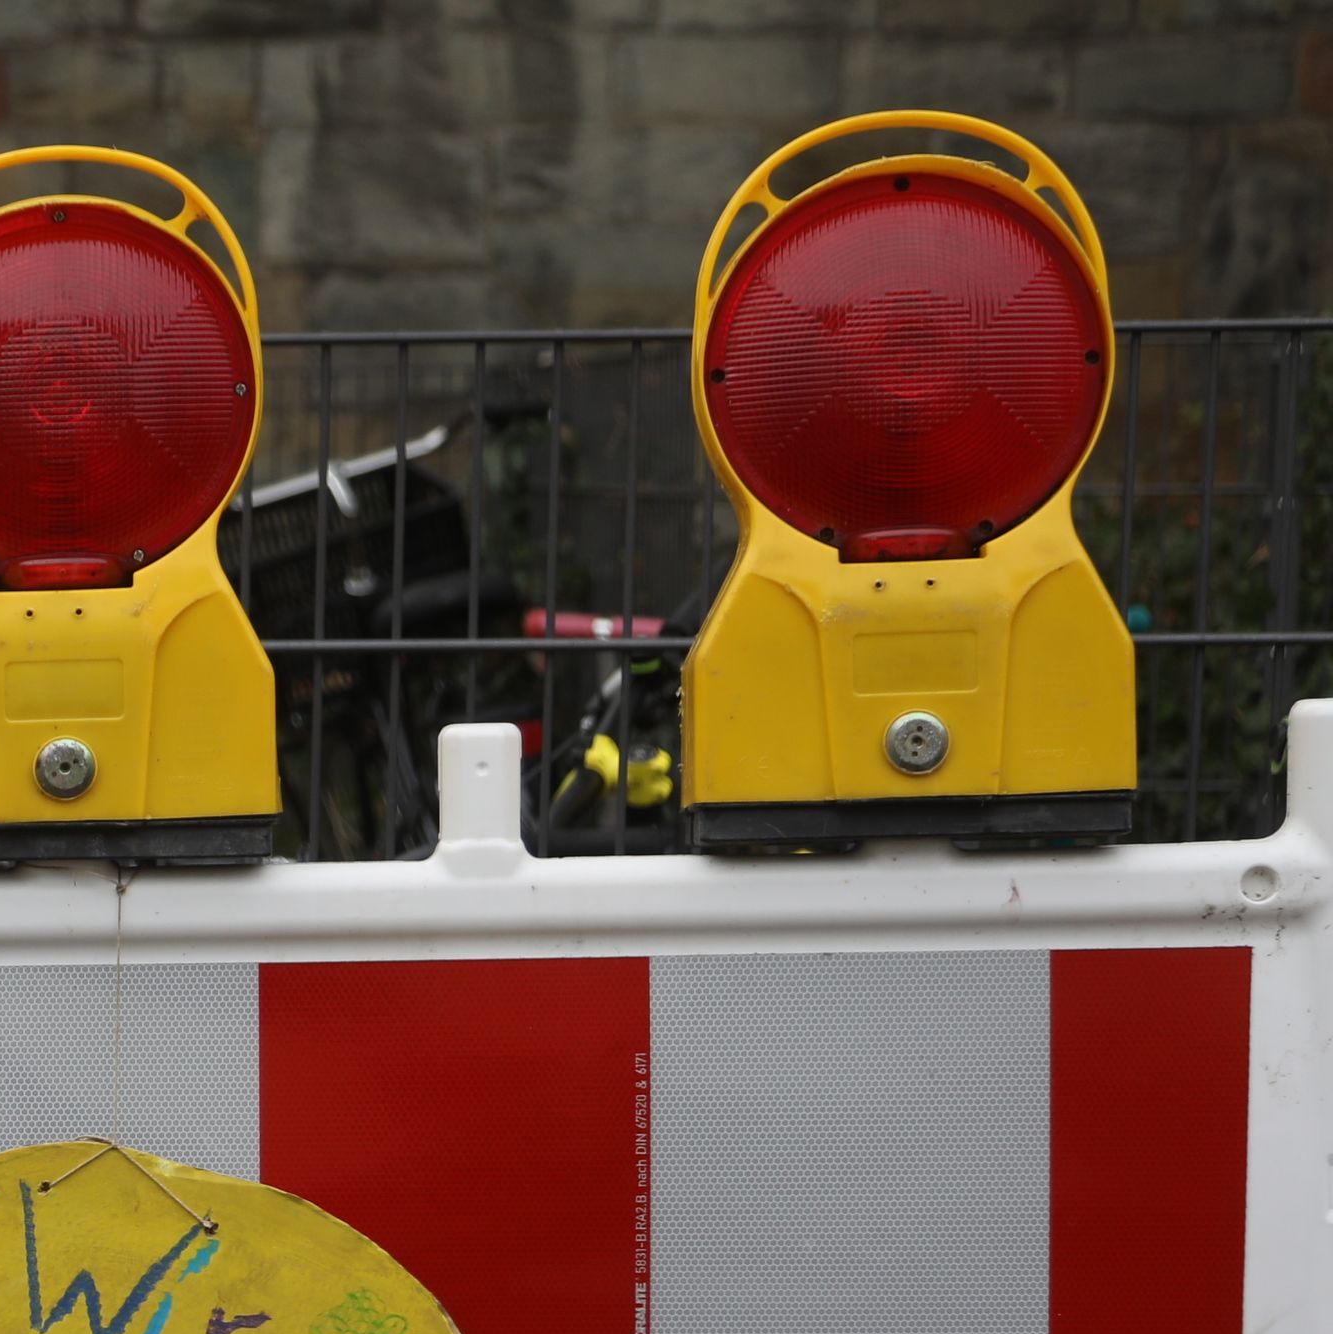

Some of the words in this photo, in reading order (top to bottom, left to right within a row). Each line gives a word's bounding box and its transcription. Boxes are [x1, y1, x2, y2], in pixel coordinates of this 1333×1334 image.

[635, 1052, 647, 1075] 6171
[635, 1080, 647, 1089] &
[635, 1094, 647, 1129] 67520
[635, 1133, 647, 1155] DIN
[636, 1160, 647, 1187] nach
